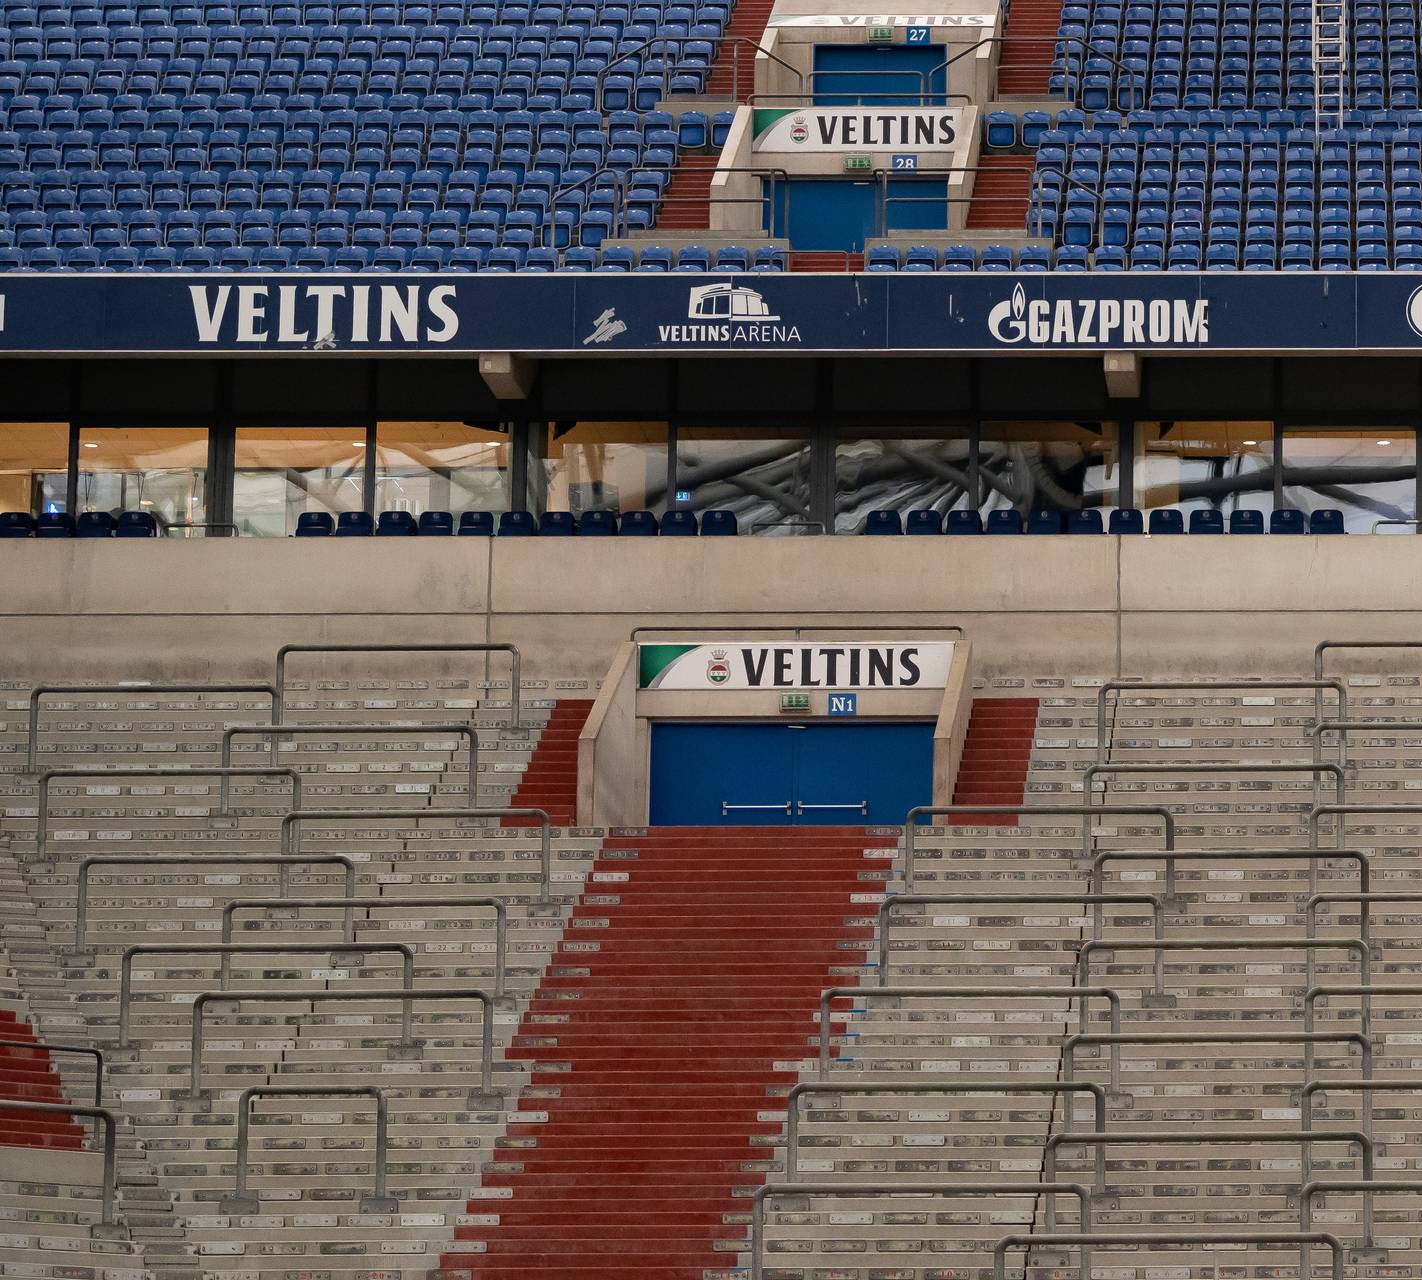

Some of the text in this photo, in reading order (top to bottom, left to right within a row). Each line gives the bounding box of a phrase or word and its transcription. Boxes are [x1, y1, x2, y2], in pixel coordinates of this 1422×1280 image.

[839, 16, 985, 25] VELTINS
[909, 28, 927, 41] 27
[816, 115, 956, 145] VELTINS
[896, 158, 915, 169] 28
[188, 285, 459, 342] VELTINS
[1028, 299, 1209, 343] GAZPROM
[658, 325, 802, 342] VELTINS ARENA
[740, 648, 921, 687] VELTINS
[831, 697, 854, 712] N1
